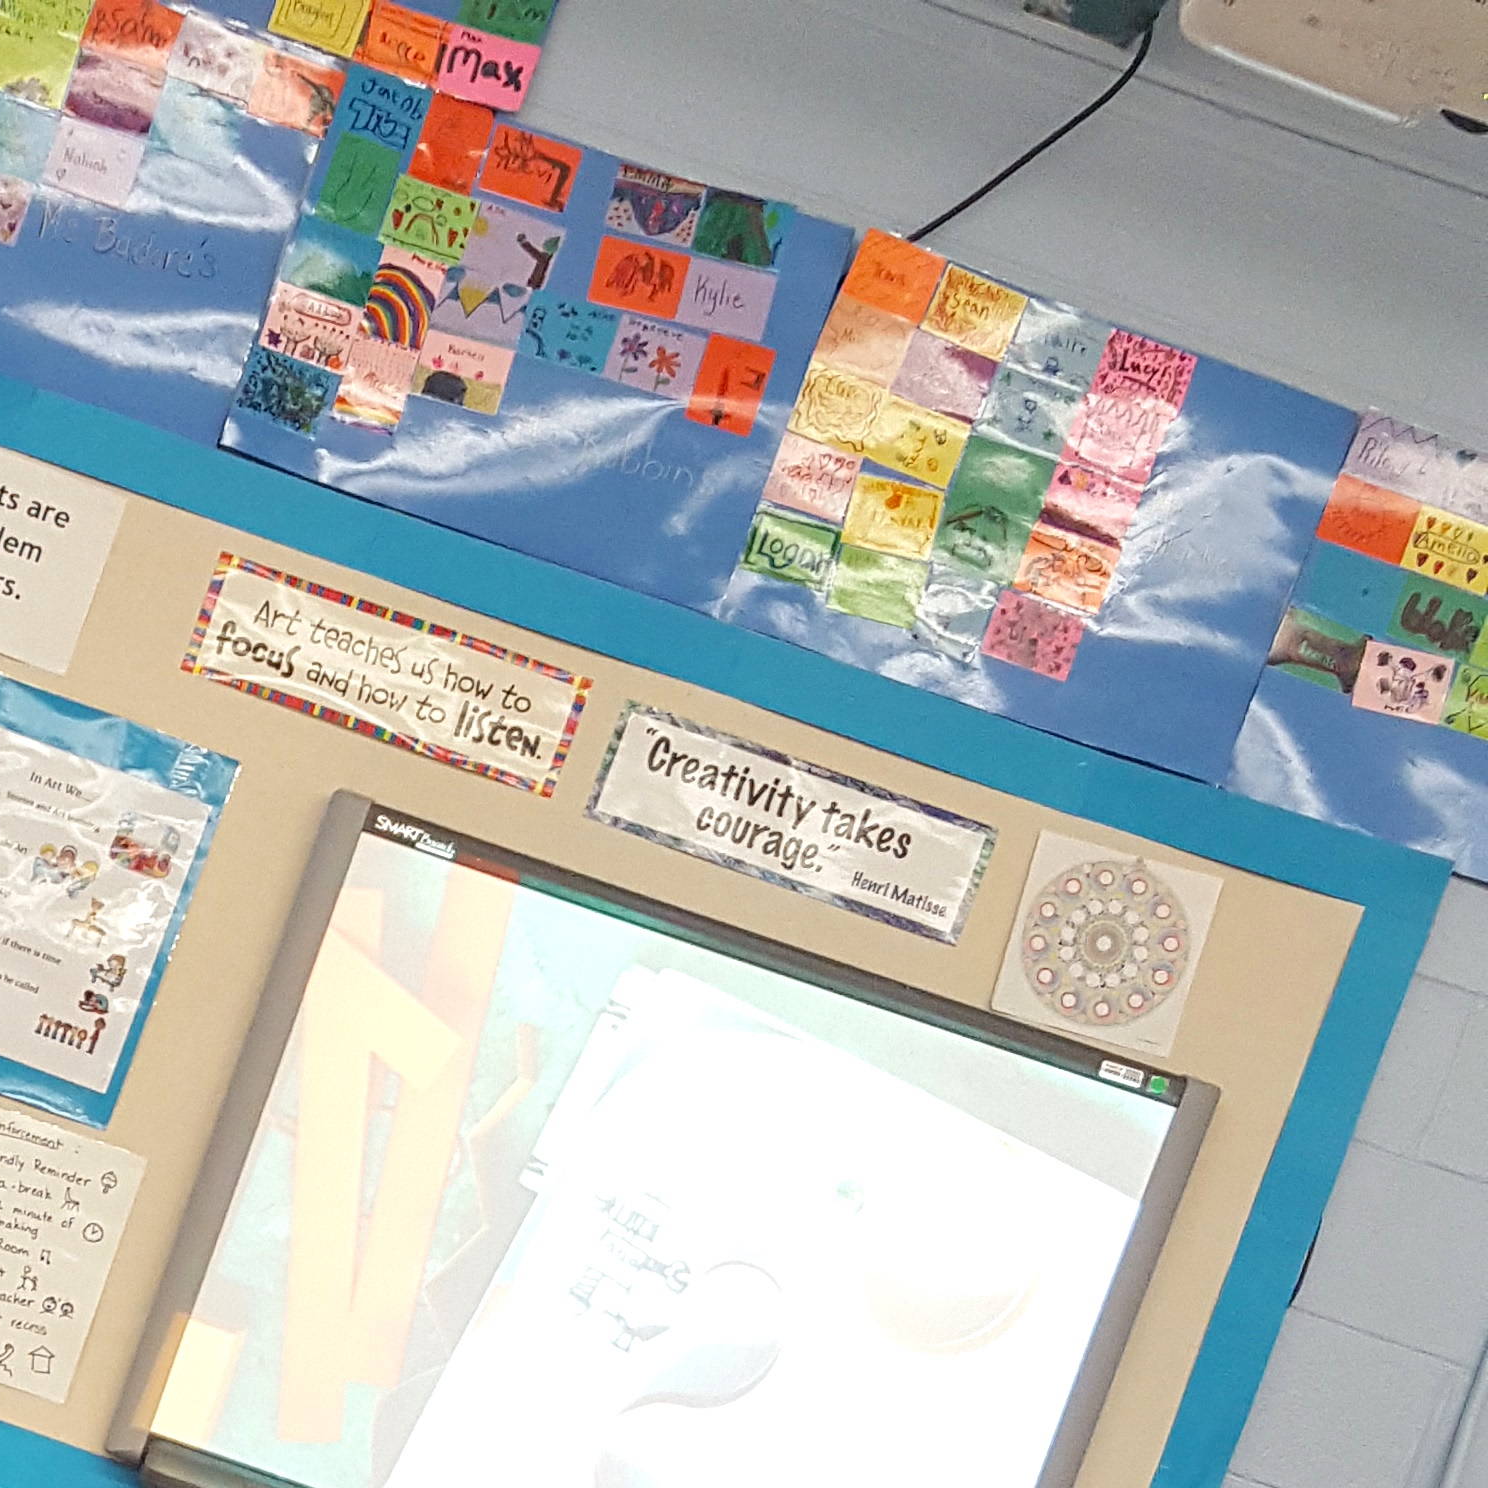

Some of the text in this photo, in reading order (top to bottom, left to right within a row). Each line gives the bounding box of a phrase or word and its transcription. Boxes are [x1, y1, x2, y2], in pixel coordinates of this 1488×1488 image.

[694, 273, 746, 317] Kylie
[25, 494, 72, 529] are
[253, 600, 532, 715] Art teaches us how to
[215, 619, 544, 761] focus and how to listen.
[29, 771, 68, 793] In Art
[374, 814, 424, 841] SMART
[820, 797, 913, 861] takes
[851, 870, 949, 918] Henri Matisse
[10, 940, 32, 955] there
[14, 979, 40, 994] called
[34, 1159, 92, 1187] Reminder
[12, 1206, 54, 1224] minute
[61, 1217, 75, 1229] of
